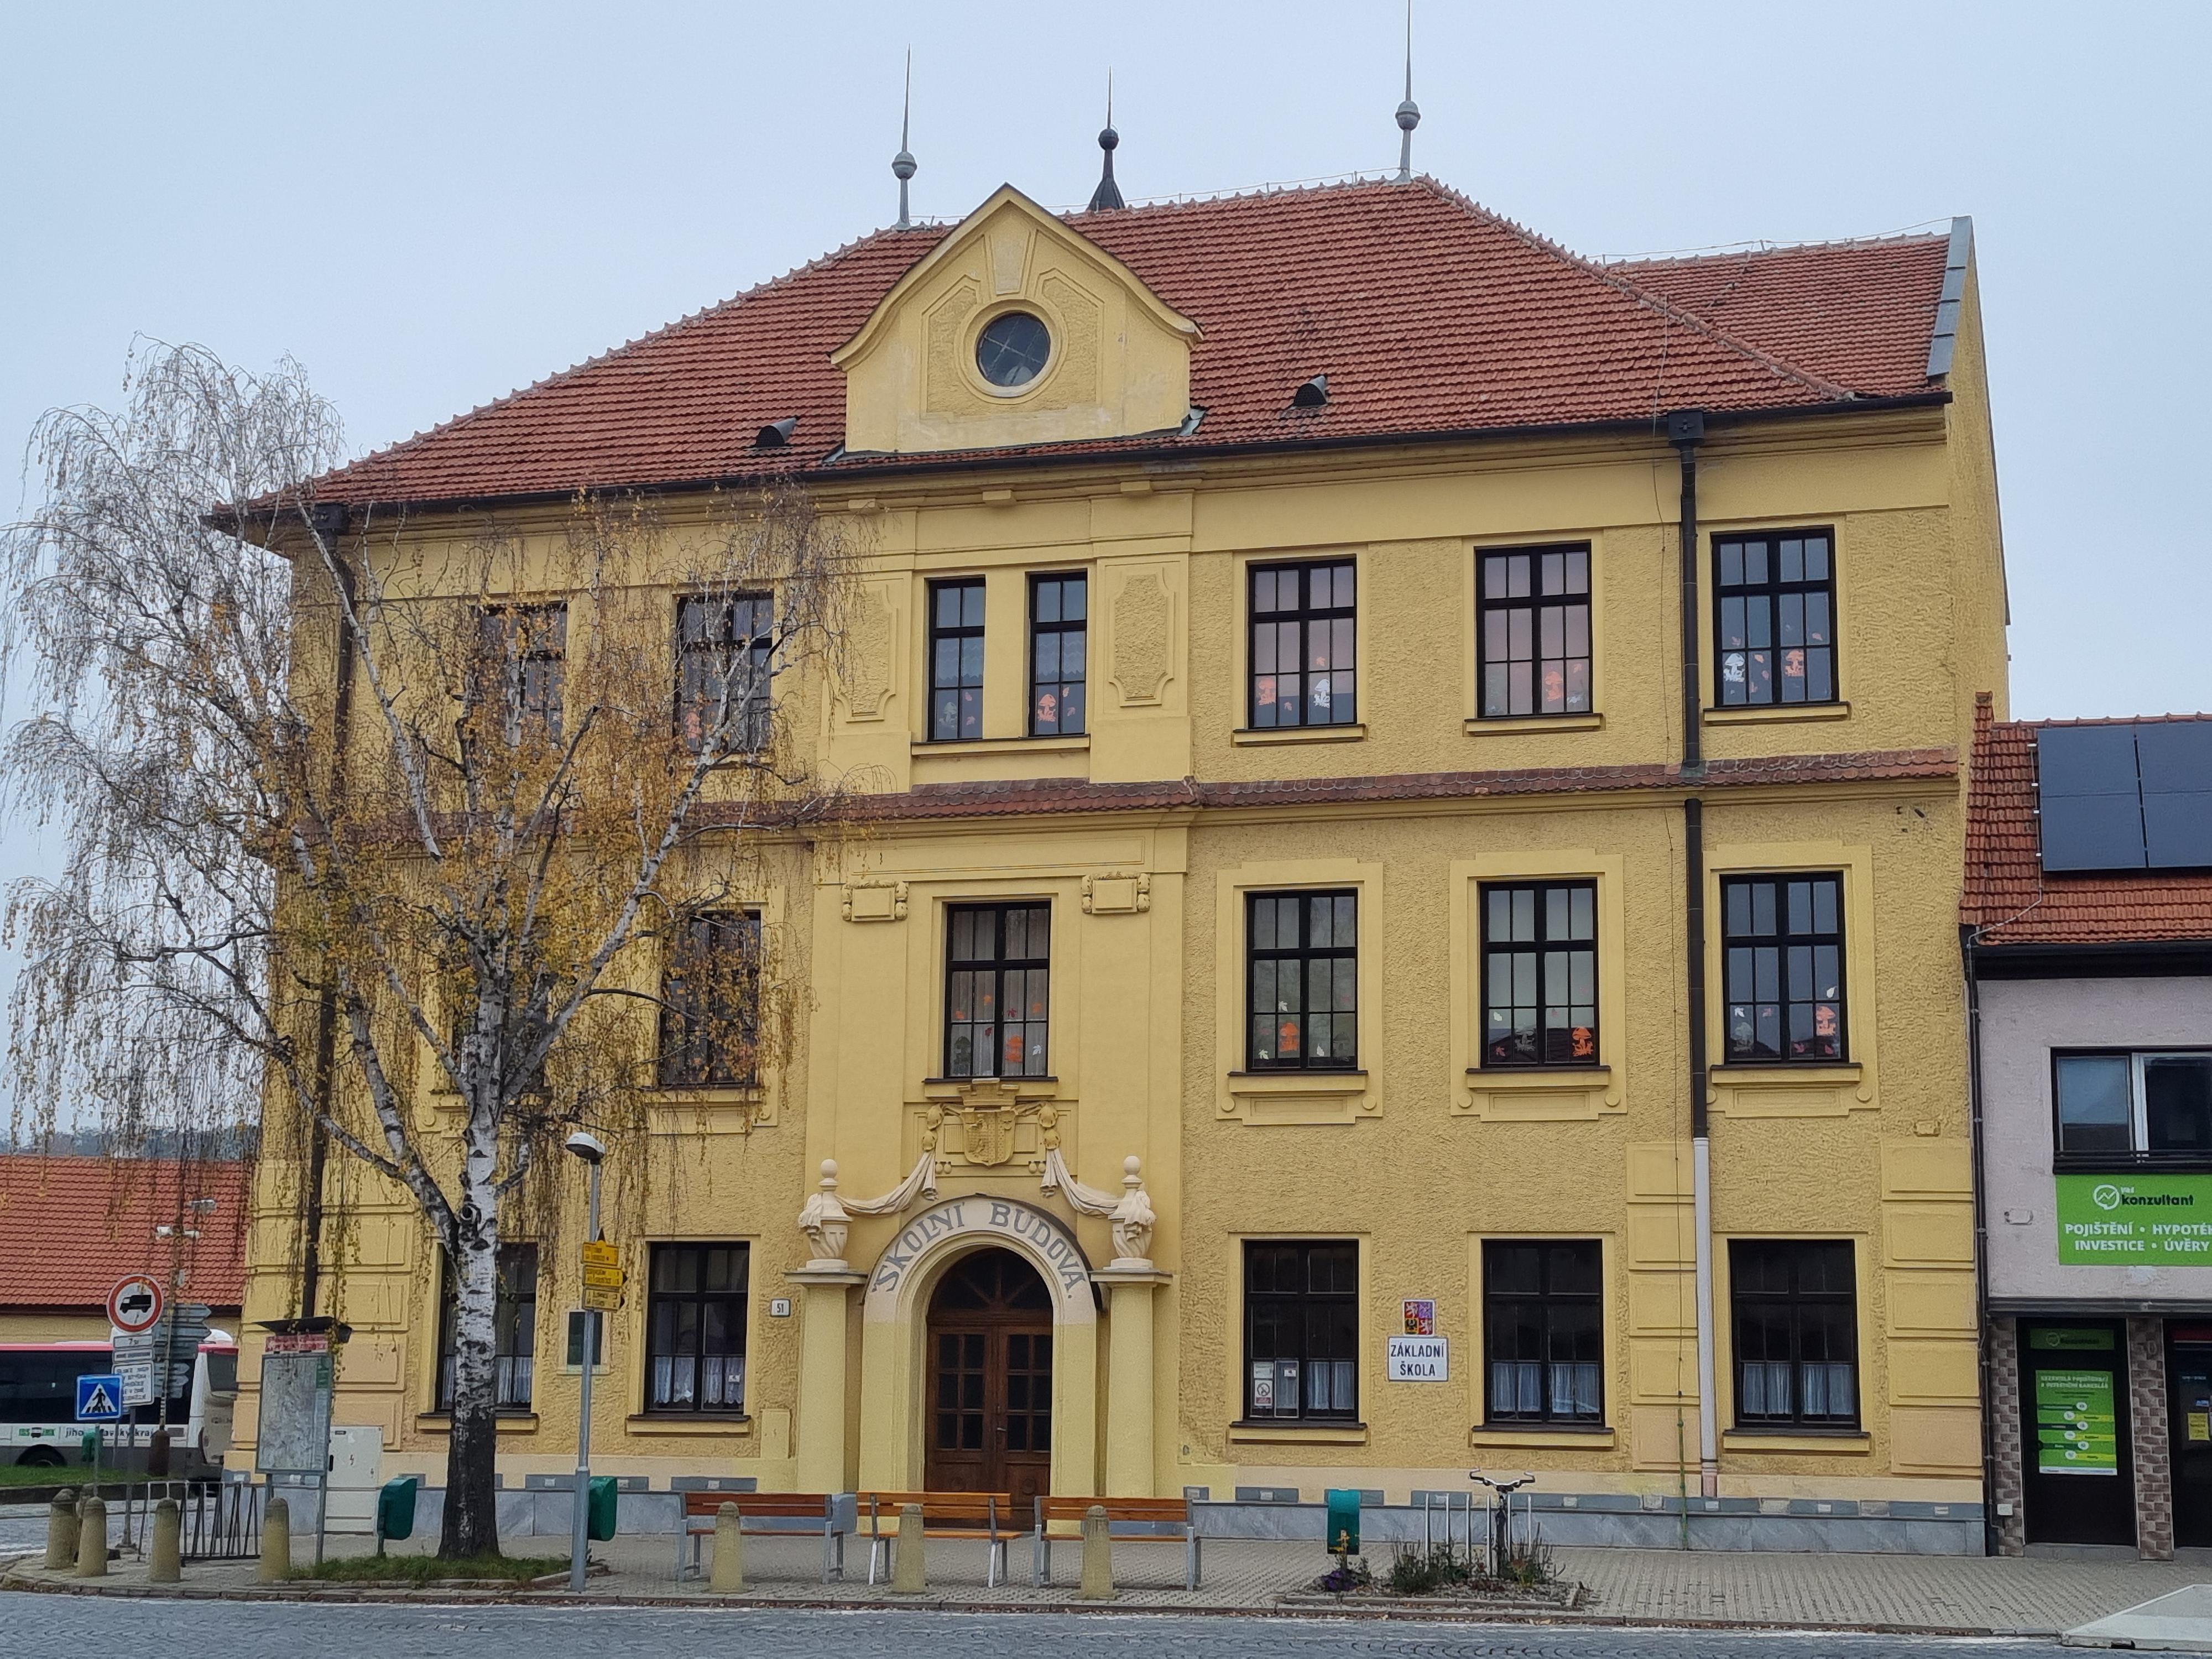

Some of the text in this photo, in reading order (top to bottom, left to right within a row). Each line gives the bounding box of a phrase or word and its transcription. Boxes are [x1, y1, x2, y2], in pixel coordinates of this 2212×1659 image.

[2121, 1194, 2194, 1205] konzultant
[2065, 1221, 2133, 1237] POJIŠTĚNÍ
[2075, 1238, 2210, 1251] INVESTICE ÚVĚRY
[777, 1303, 784, 1313] 51
[1391, 1342, 1444, 1357] ZÁKLADNÍ
[1400, 1361, 1436, 1376] ŠKOLA
